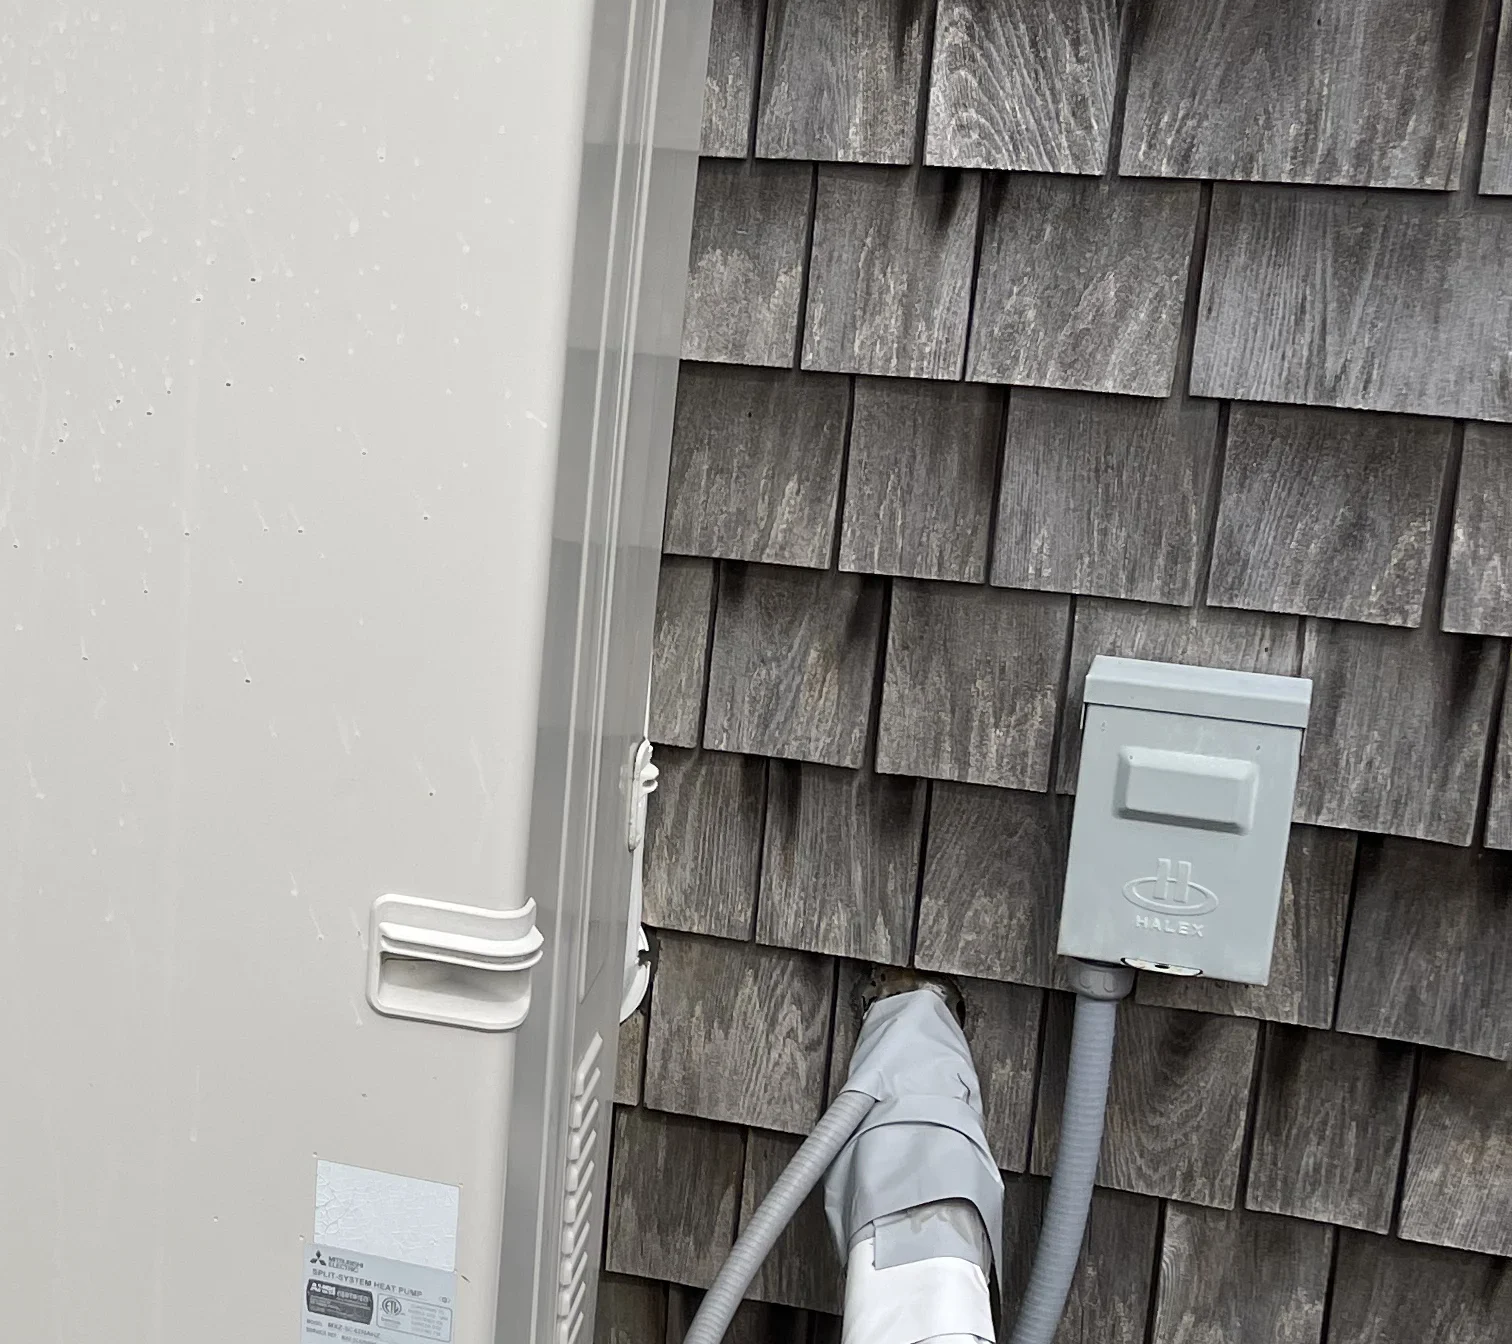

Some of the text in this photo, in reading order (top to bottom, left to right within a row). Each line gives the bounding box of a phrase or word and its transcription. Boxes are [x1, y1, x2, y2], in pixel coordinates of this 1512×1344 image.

[1136, 914, 1205, 937] HALEX
[312, 1268, 422, 1297] SPLIT-SYSTEM HEAT PUMP
